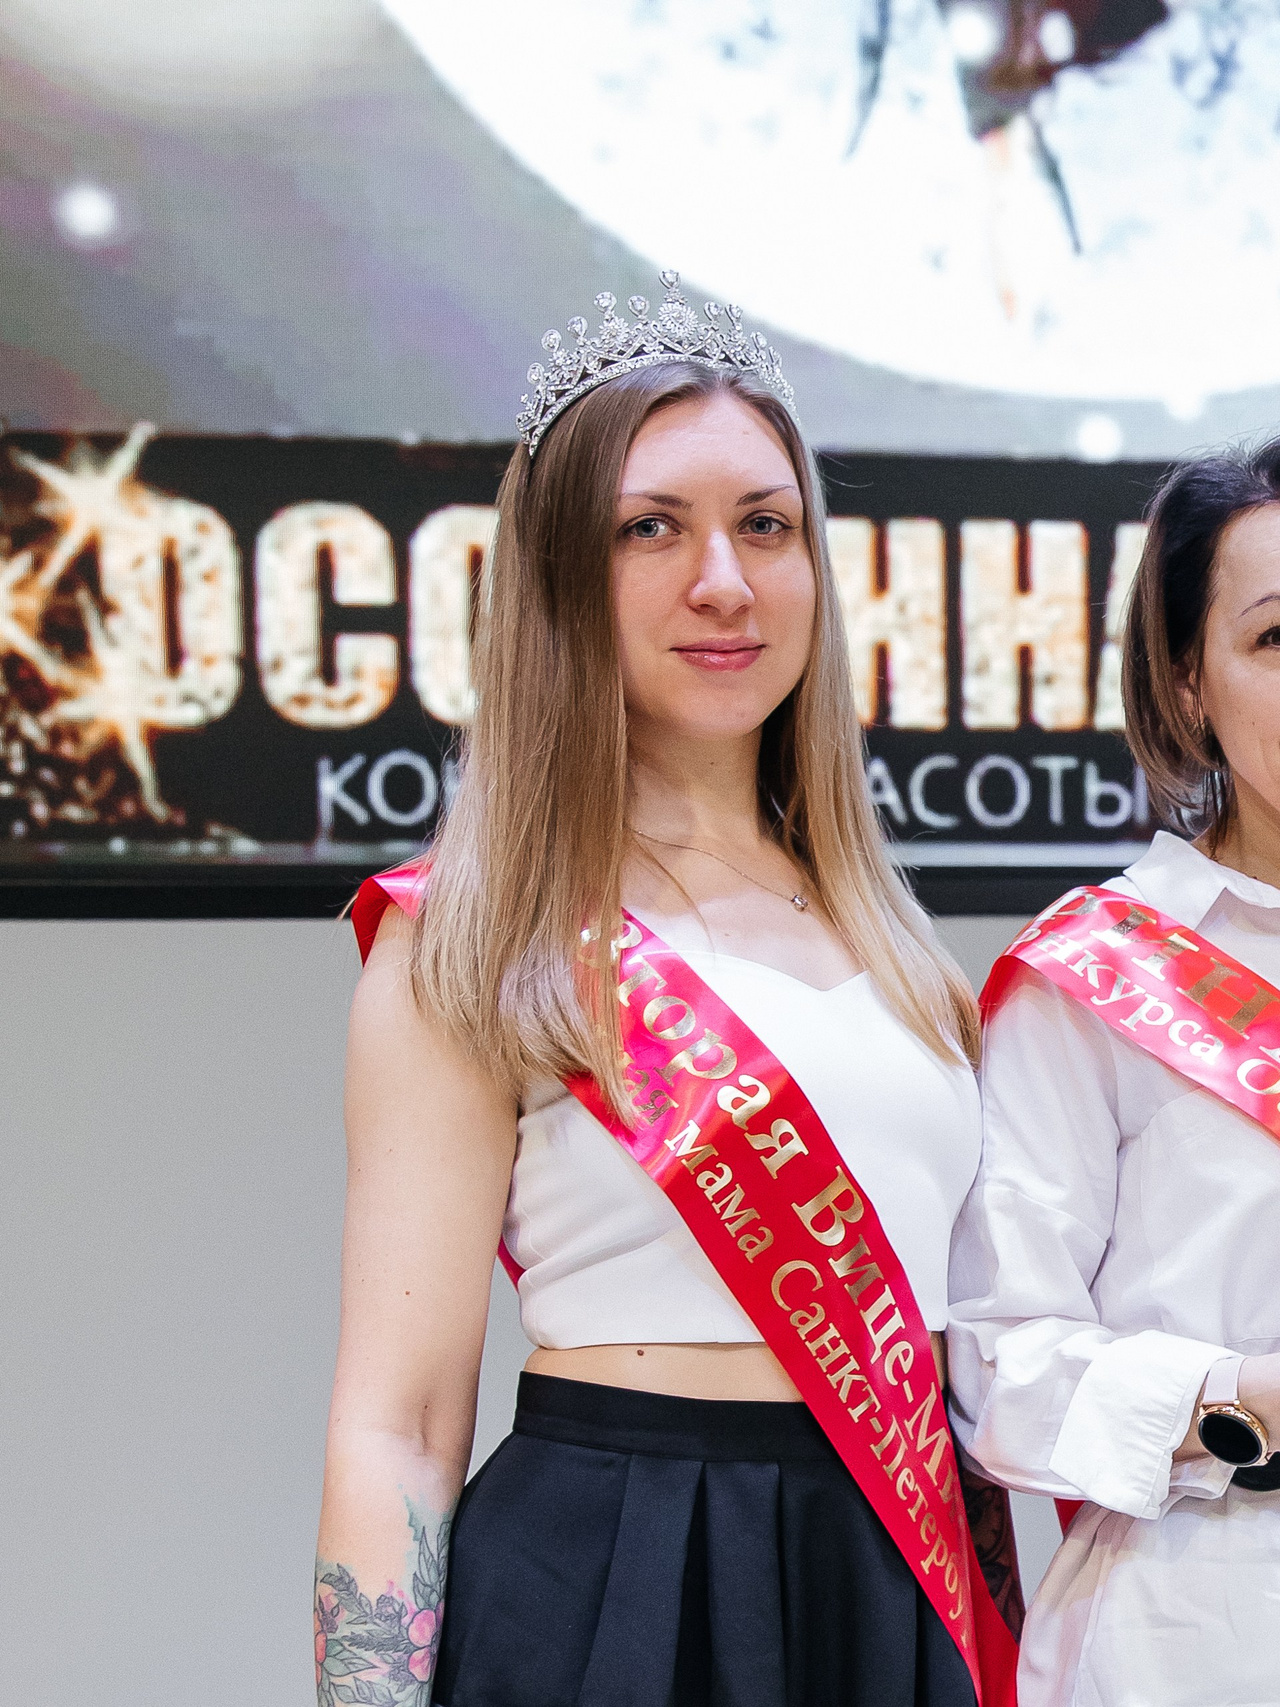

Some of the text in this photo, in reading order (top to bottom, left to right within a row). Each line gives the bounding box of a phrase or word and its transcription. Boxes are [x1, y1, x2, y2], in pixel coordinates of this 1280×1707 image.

[867, 753, 1150, 829] АСОТЫ
[1010, 928, 1226, 1066] онкурса
[663, 1119, 775, 1264] мама
